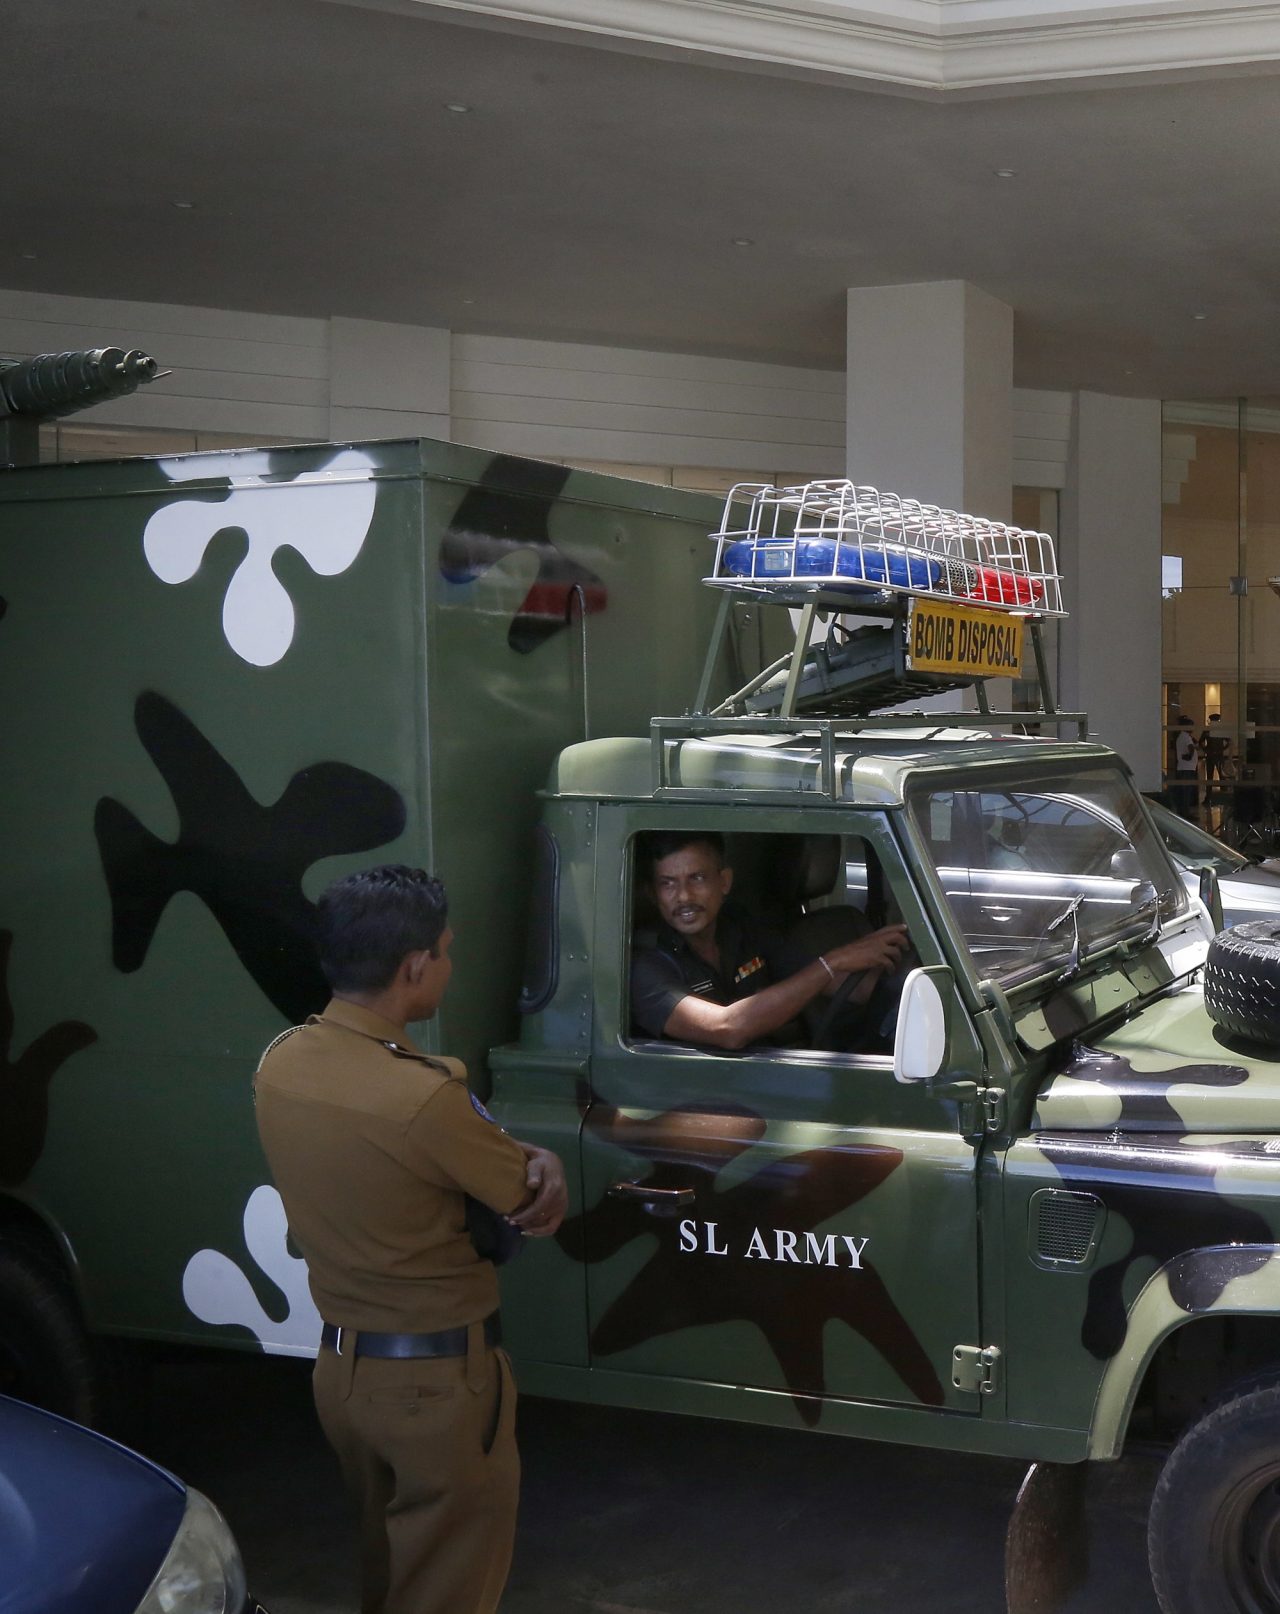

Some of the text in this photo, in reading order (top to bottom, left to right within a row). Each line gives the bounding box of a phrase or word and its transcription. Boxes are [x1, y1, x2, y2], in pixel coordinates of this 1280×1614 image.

[915, 613, 1017, 668] BOMB DISPOSAL
[679, 1219, 870, 1270] SL ARMY
